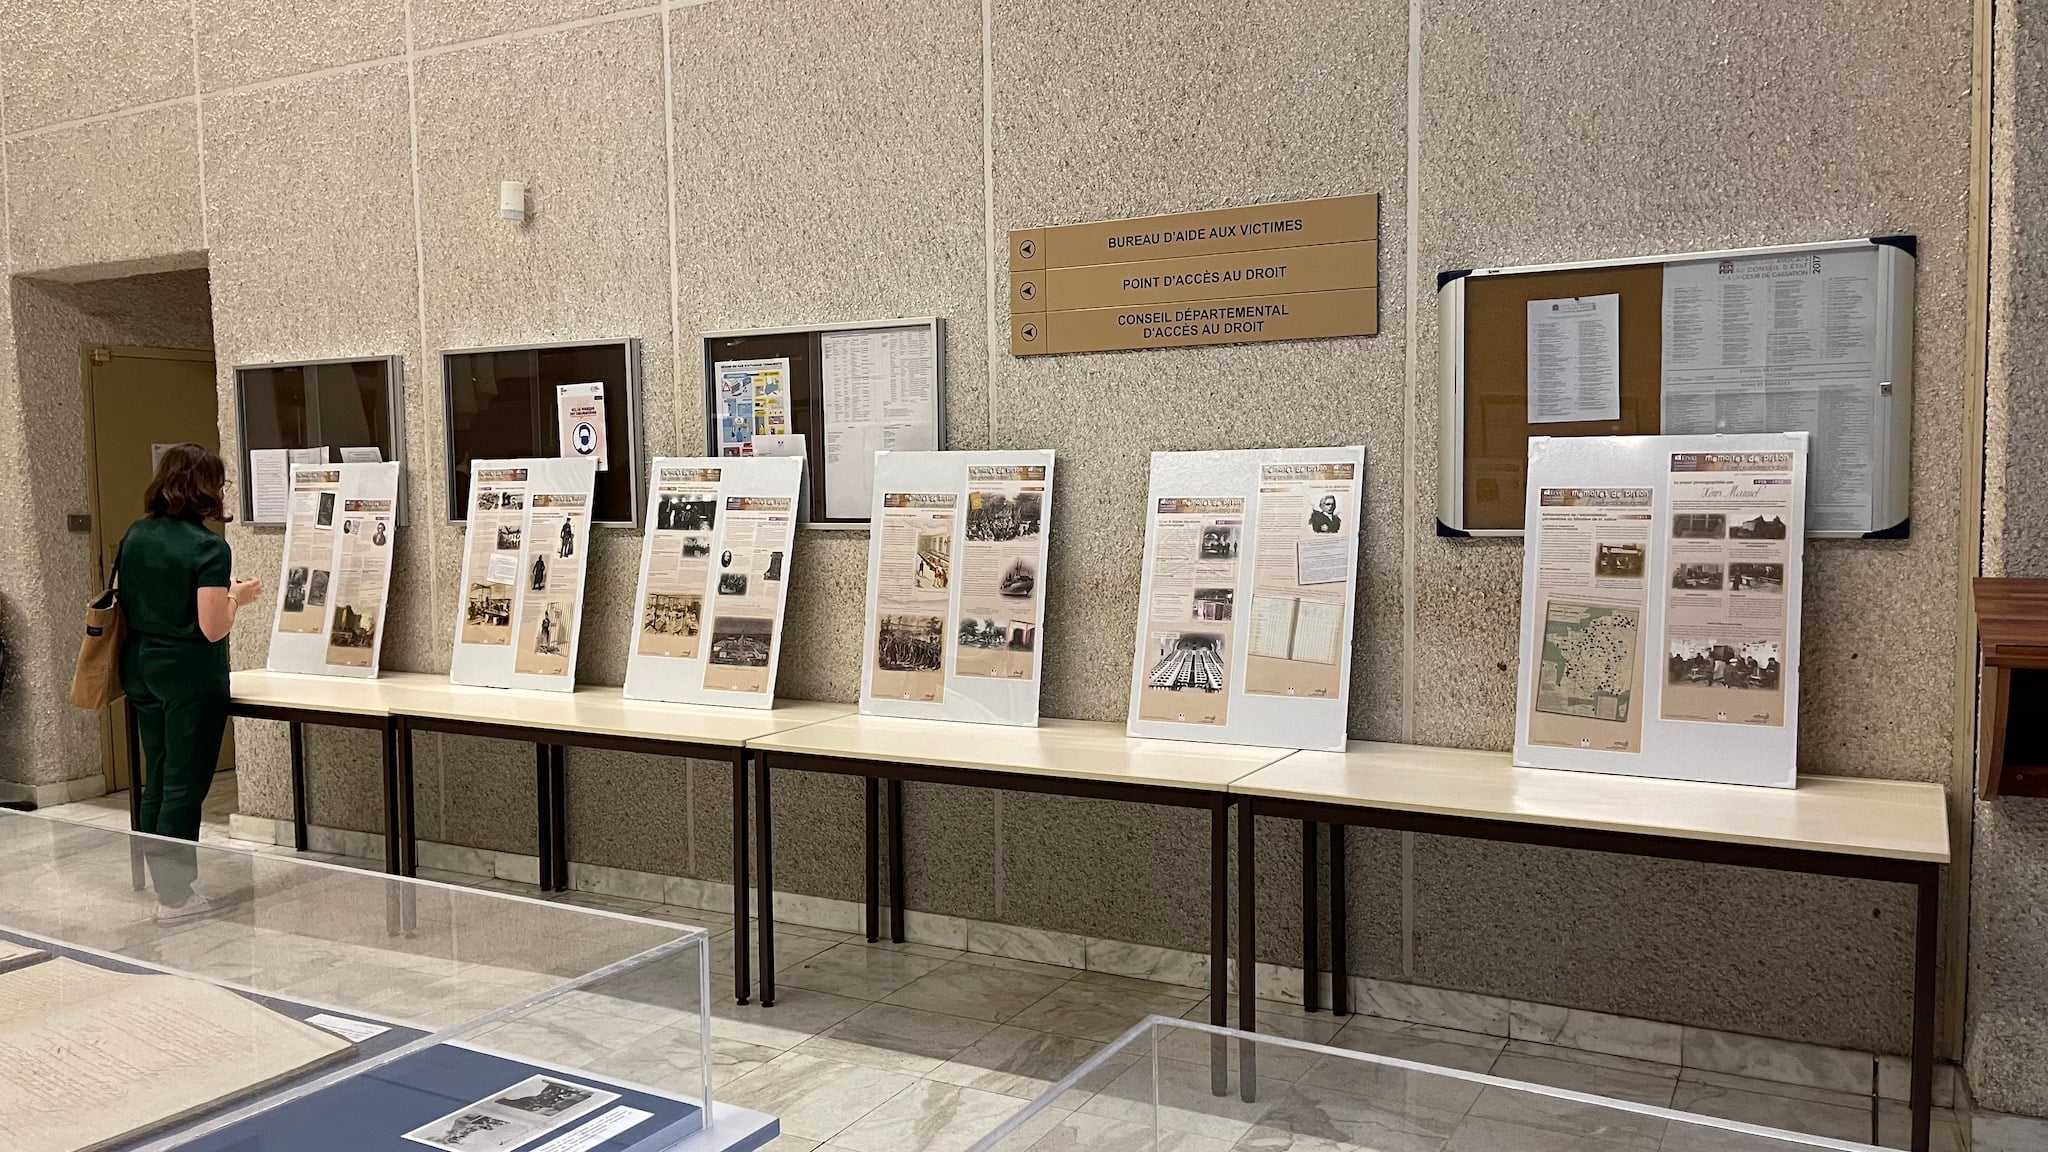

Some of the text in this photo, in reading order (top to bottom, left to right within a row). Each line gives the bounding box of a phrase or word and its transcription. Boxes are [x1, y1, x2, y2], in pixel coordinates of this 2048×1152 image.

[1108, 219, 1303, 249] BUREAU D'AIDE AUX VICTIMES
[1812, 255, 1821, 274] 2017
[1123, 266, 1287, 290] POINT D'ACCÈS AU DROIT
[1117, 304, 1289, 326] CONSEIL DÉPARTEMENTAL
[1143, 321, 1265, 339] D'ACCÈS AU DROIT
